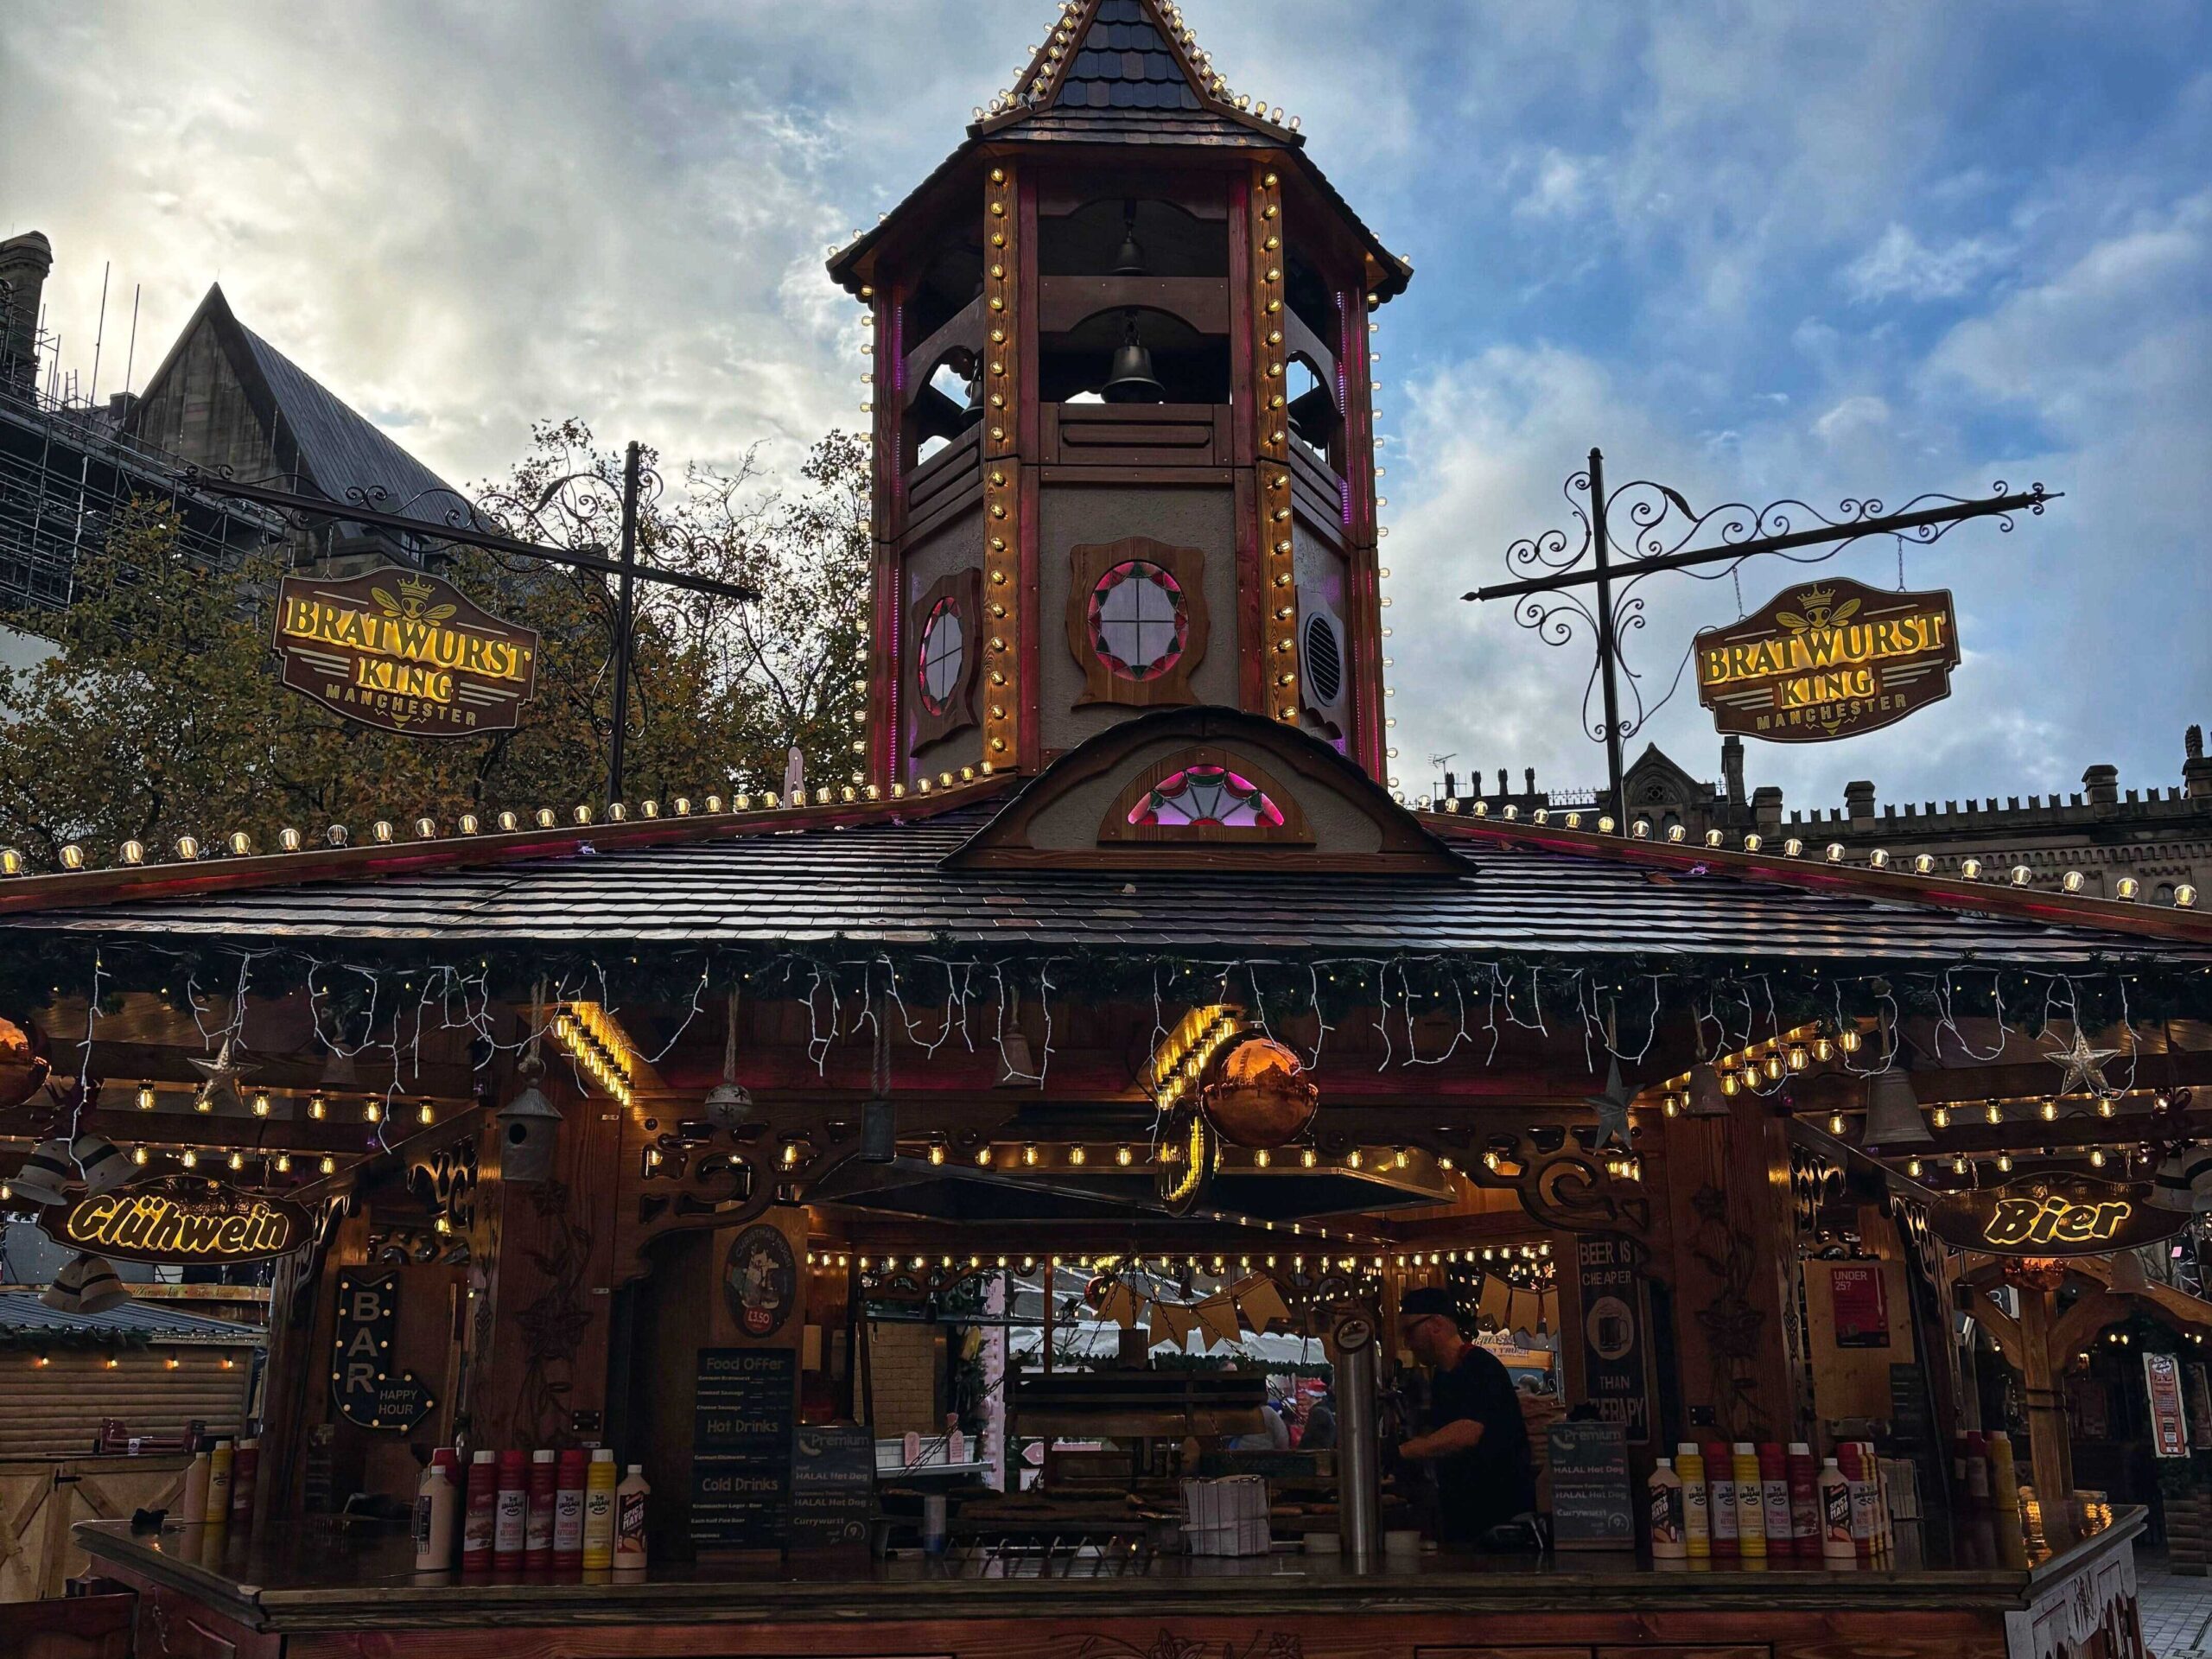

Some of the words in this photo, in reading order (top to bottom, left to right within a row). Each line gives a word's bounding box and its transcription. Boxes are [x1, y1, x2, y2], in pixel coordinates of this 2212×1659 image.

[283, 595, 531, 683] BRATWURST
[1700, 610, 1946, 685] BRATWURST
[356, 657, 454, 703] KING
[1779, 667, 1876, 710] KING
[326, 683, 476, 726] MANCHESTER
[1757, 693, 1907, 731] MANCHESTER
[67, 1195, 289, 1253] Glühwein
[1983, 1196, 2132, 1244] Bier
[1580, 1241, 1614, 1266] BEER
[1619, 1240, 1631, 1263] IS
[1582, 1270, 1631, 1286] CHEAPER
[1834, 1270, 1867, 1281] UNDER
[1834, 1281, 1852, 1291] 25?
[346, 1291, 381, 1394] BAR
[706, 1357, 741, 1370] Food
[743, 1357, 785, 1370] Offer
[1599, 1376, 1630, 1390] THAN
[380, 1389, 418, 1402] HAPPY
[378, 1403, 414, 1415] HOUR
[707, 1420, 732, 1433] Hot
[735, 1420, 779, 1433] Drinks
[811, 1434, 869, 1447] Premium
[1564, 1429, 1622, 1441] Premium
[849, 1472, 868, 1483] Dog
[1606, 1465, 1624, 1475] Dog
[702, 1477, 732, 1492] Cold
[735, 1477, 779, 1492] Drinks
[795, 1498, 827, 1507] HALAL
[848, 1498, 867, 1509] Dog
[1829, 1494, 1848, 1511] SPICY
[623, 1502, 644, 1520] SPICY
[1830, 1502, 1849, 1520] MAYO
[622, 1510, 644, 1531] MAYO
